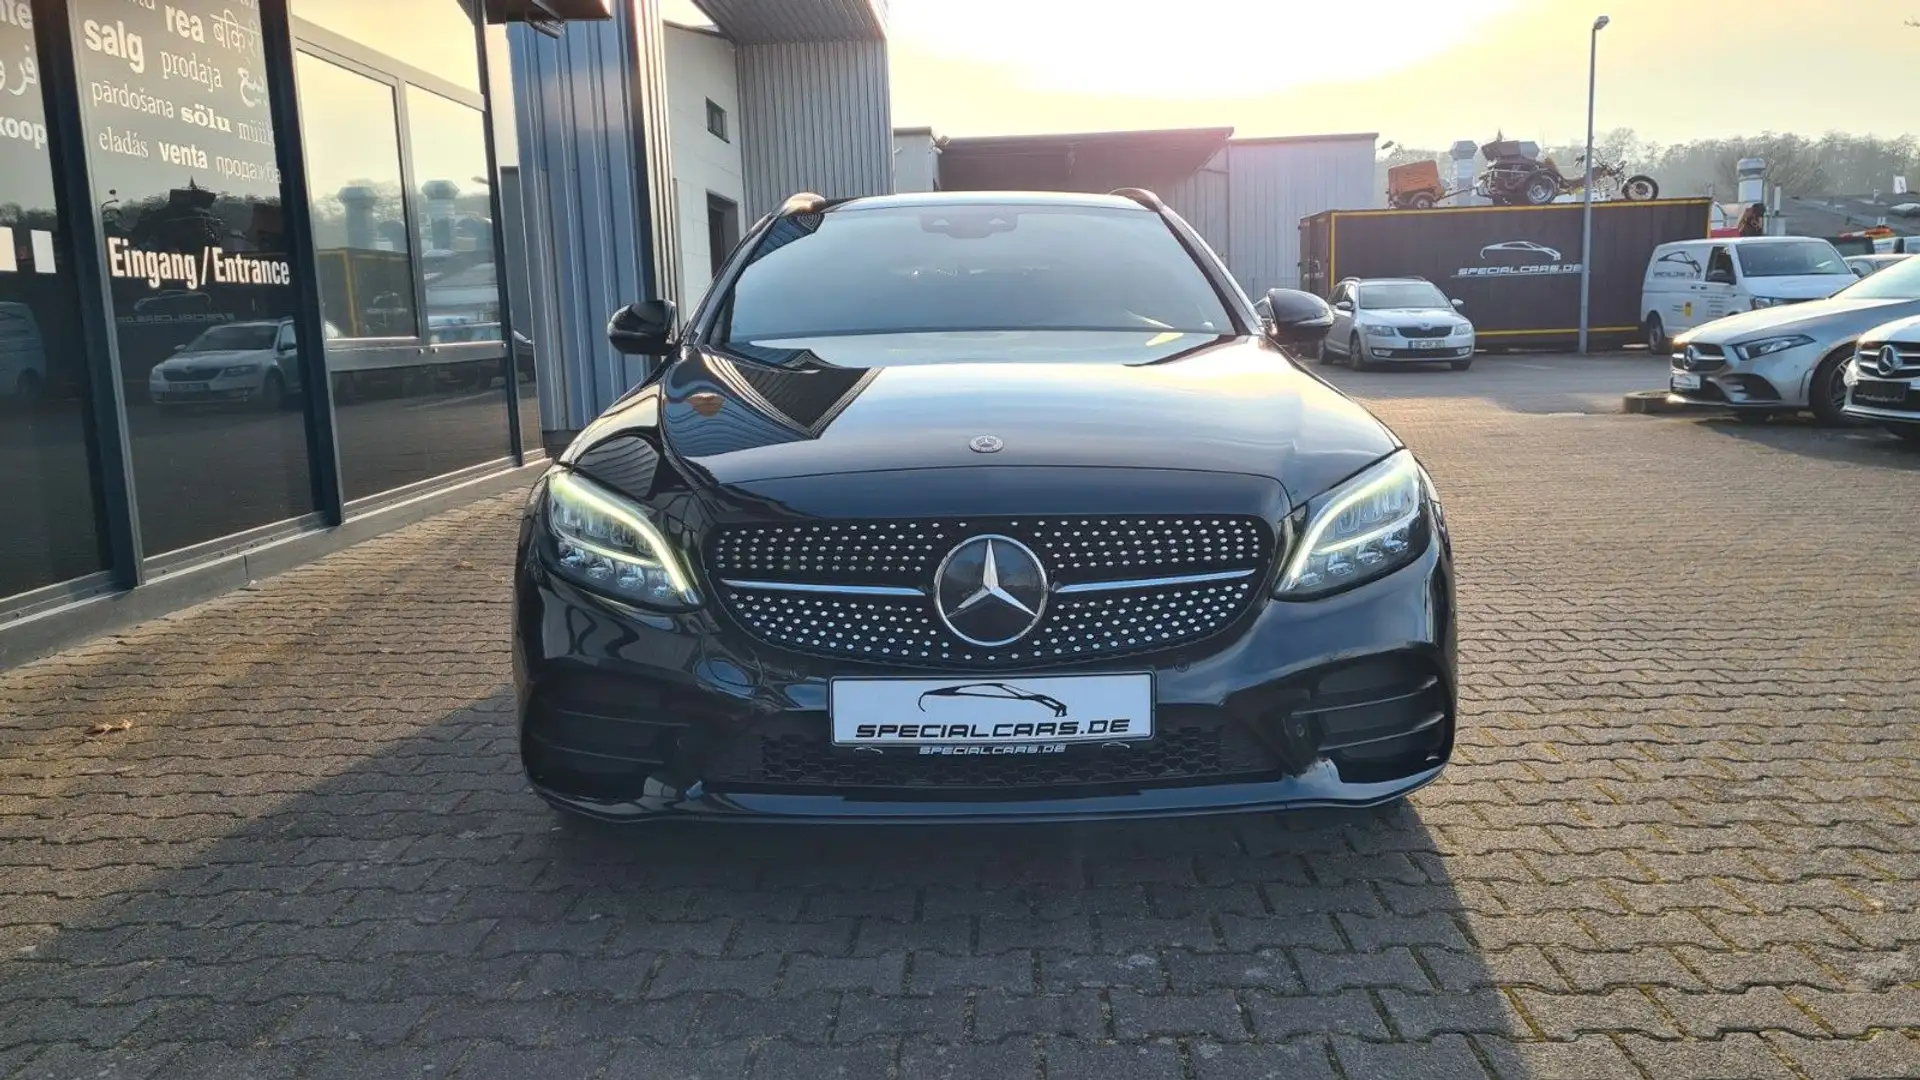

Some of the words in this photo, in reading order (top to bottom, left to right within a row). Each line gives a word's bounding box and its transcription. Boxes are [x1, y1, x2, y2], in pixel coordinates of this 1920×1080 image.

[165, 5, 205, 43] rea
[84, 19, 145, 73] salg
[160, 51, 223, 93] prodaja
[92, 80, 174, 118] pārdošana
[181, 104, 232, 133] sölu
[100, 126, 149, 158] eladás
[158, 141, 208, 169] venta
[855, 719, 1130, 738] SPECIALCARS.DE
[918, 743, 1067, 756] SPECIALCARS.DE
